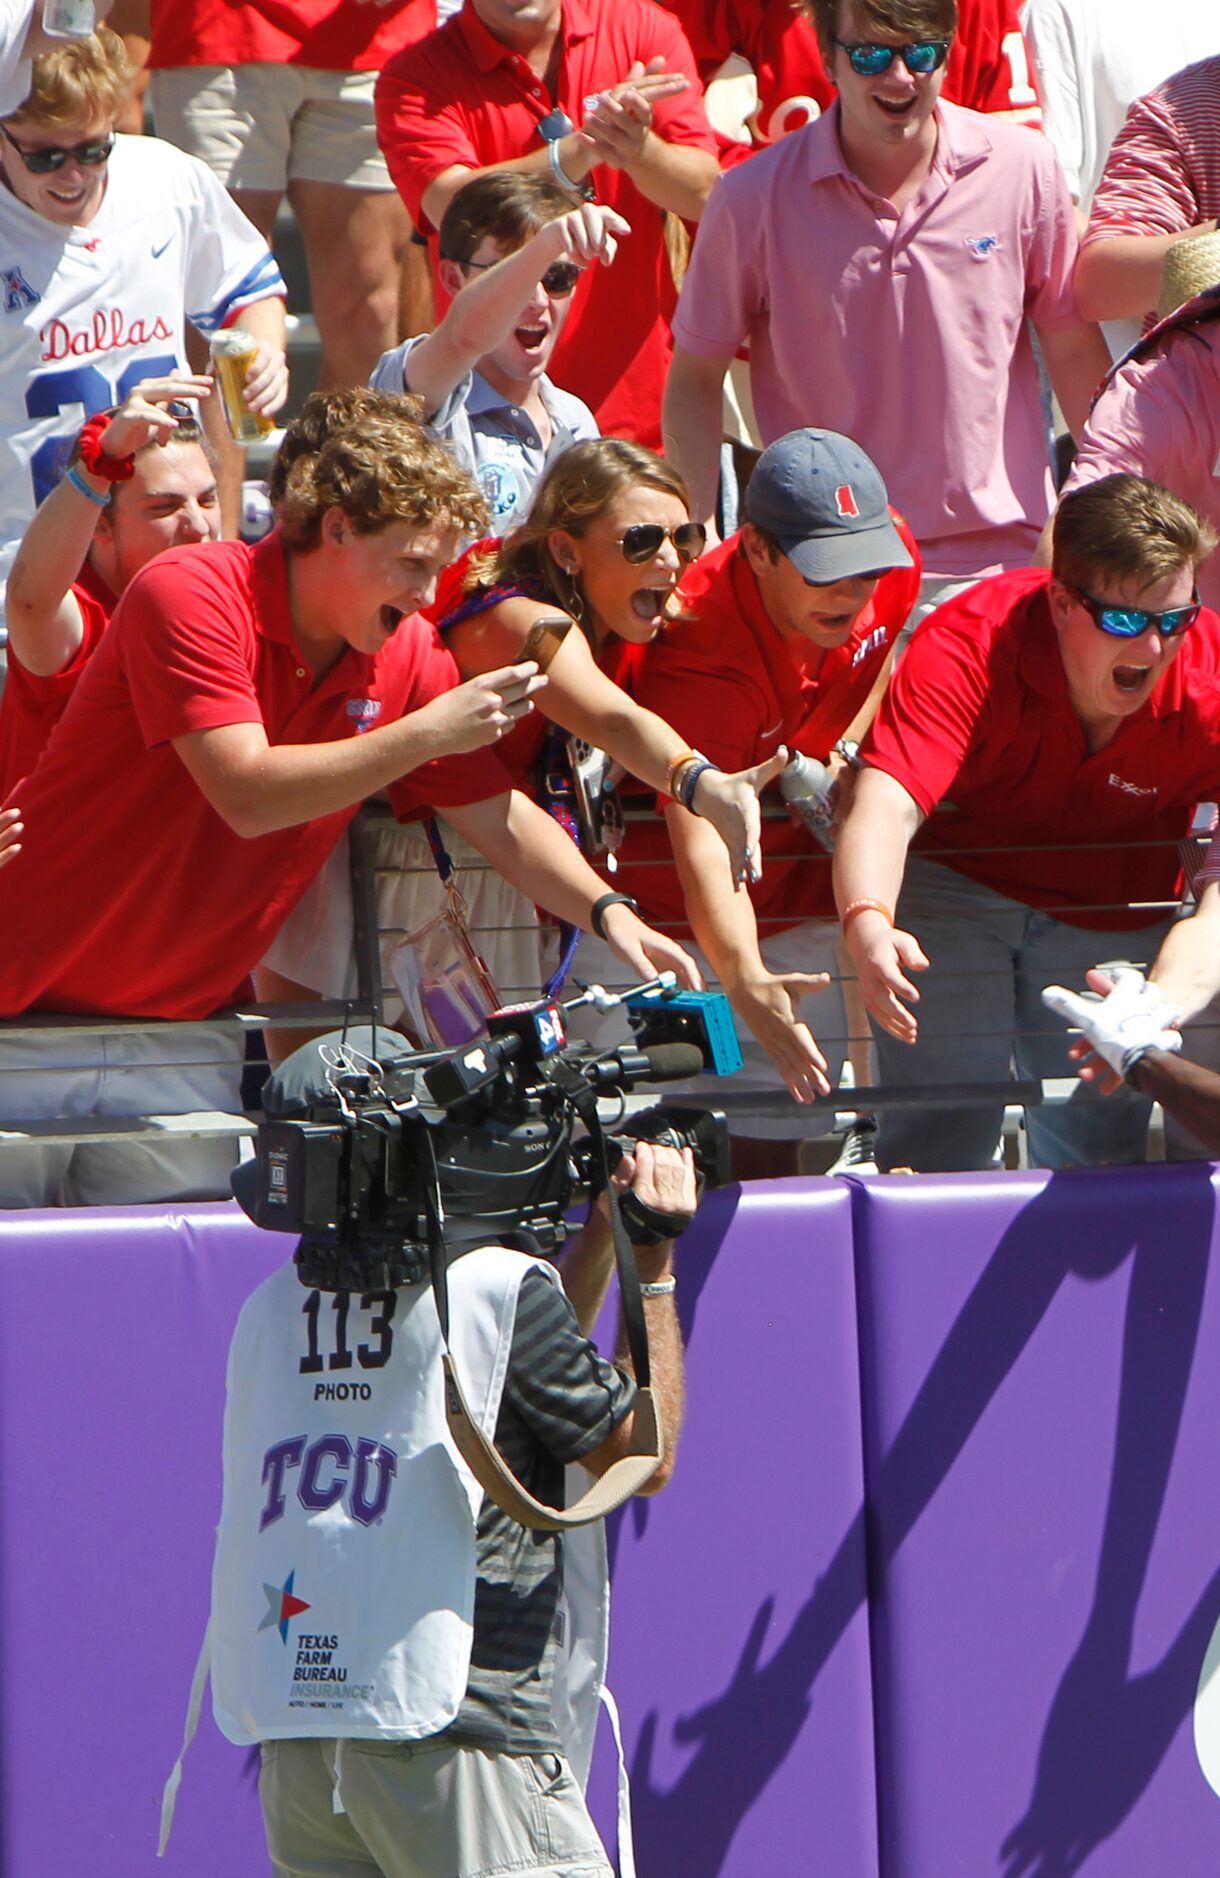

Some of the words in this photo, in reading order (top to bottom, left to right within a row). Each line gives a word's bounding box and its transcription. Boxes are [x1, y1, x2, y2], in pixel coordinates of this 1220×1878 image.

[39, 307, 173, 362] Dallas
[538, 1017, 555, 1046] 4
[523, 1141, 551, 1152] SONY
[298, 1288, 399, 1375] 113
[313, 1382, 372, 1401] PHOTO
[258, 1433, 398, 1534] TCU
[297, 1634, 339, 1650] TEXAS
[295, 1650, 333, 1666] FARM
[292, 1666, 348, 1682] BUREAU
